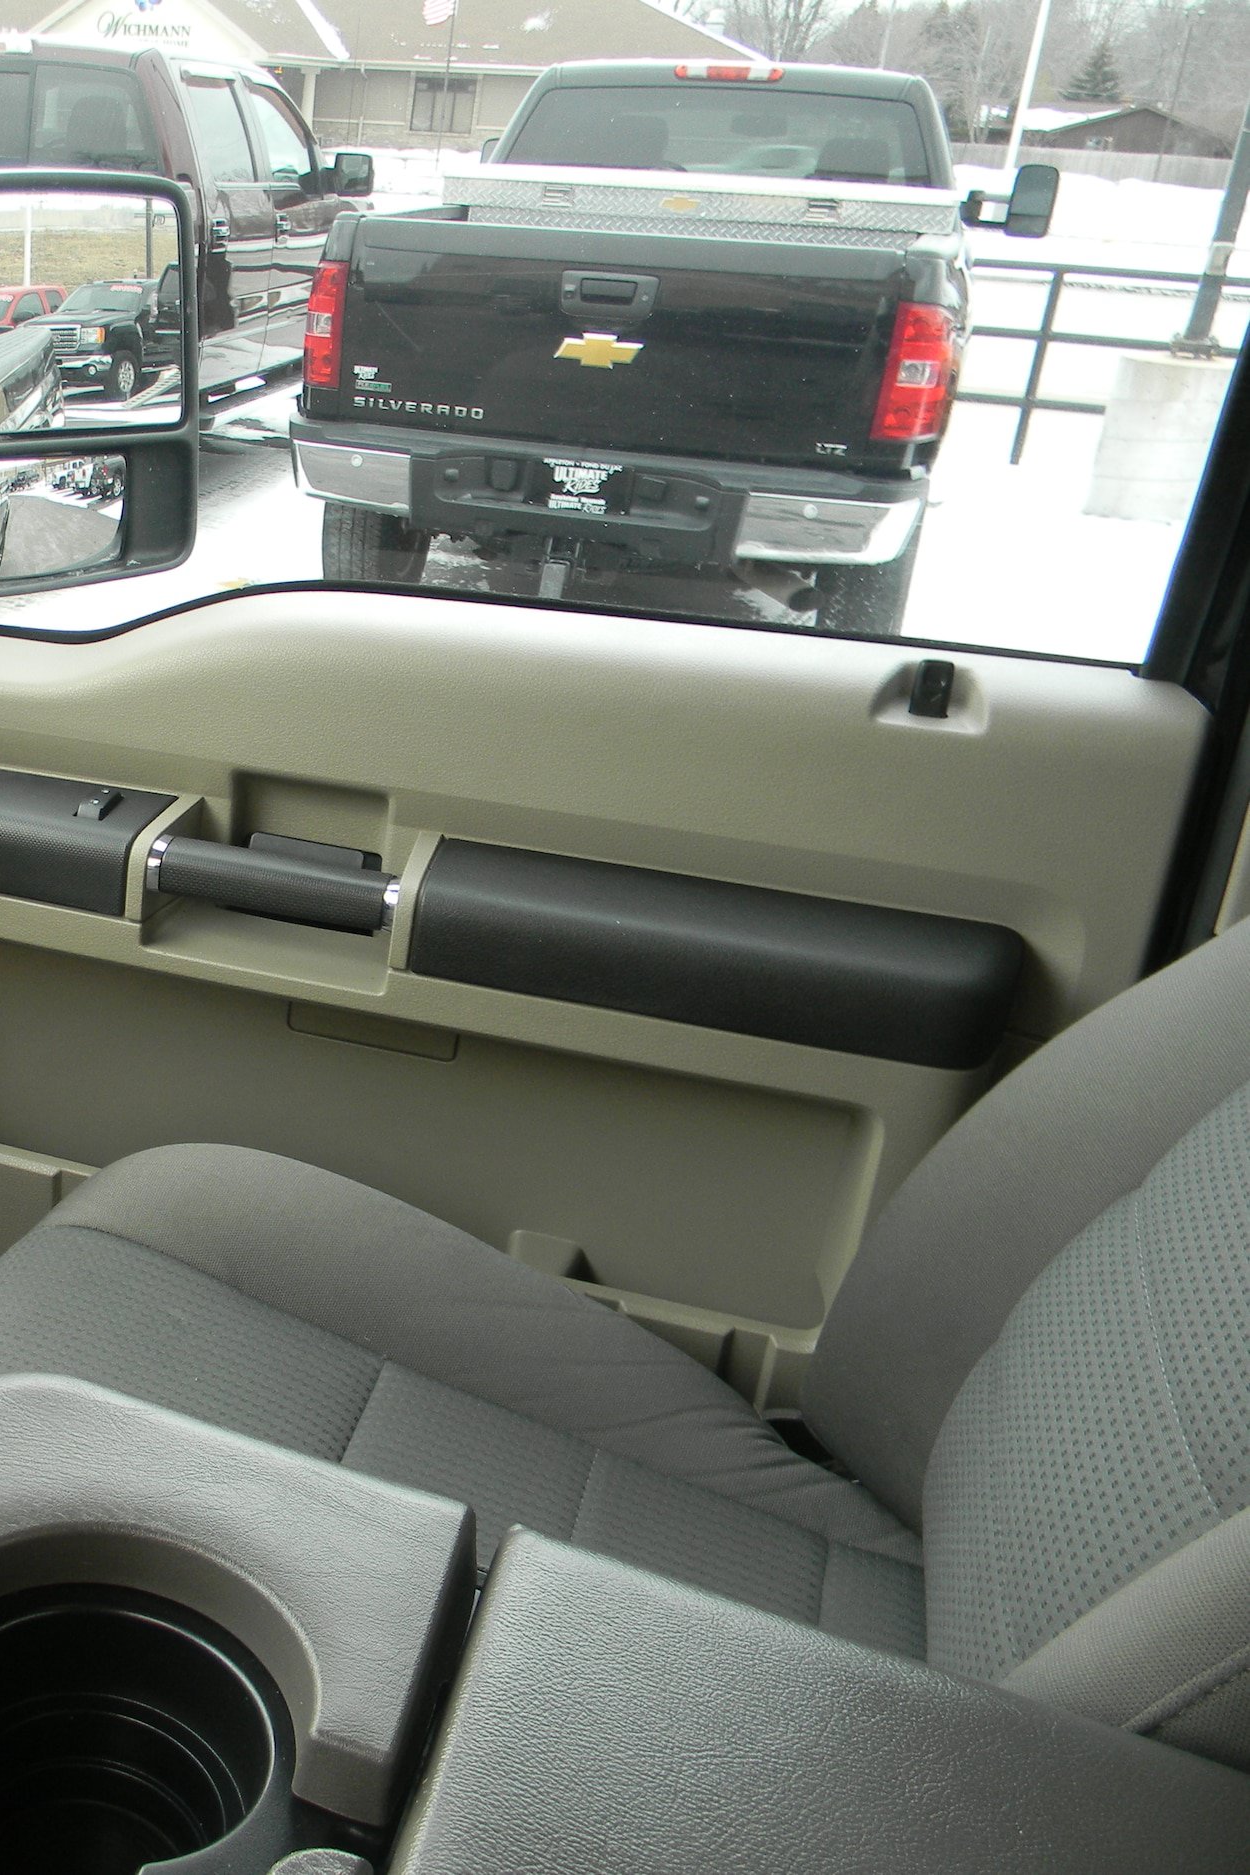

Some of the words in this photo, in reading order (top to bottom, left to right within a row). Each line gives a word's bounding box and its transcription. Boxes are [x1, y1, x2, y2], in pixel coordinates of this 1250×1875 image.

[353, 396, 484, 420] SILVERADO
[815, 442, 848, 456] LTZ
[554, 466, 608, 482] ULTIMATE
[562, 478, 600, 495] RIDES
